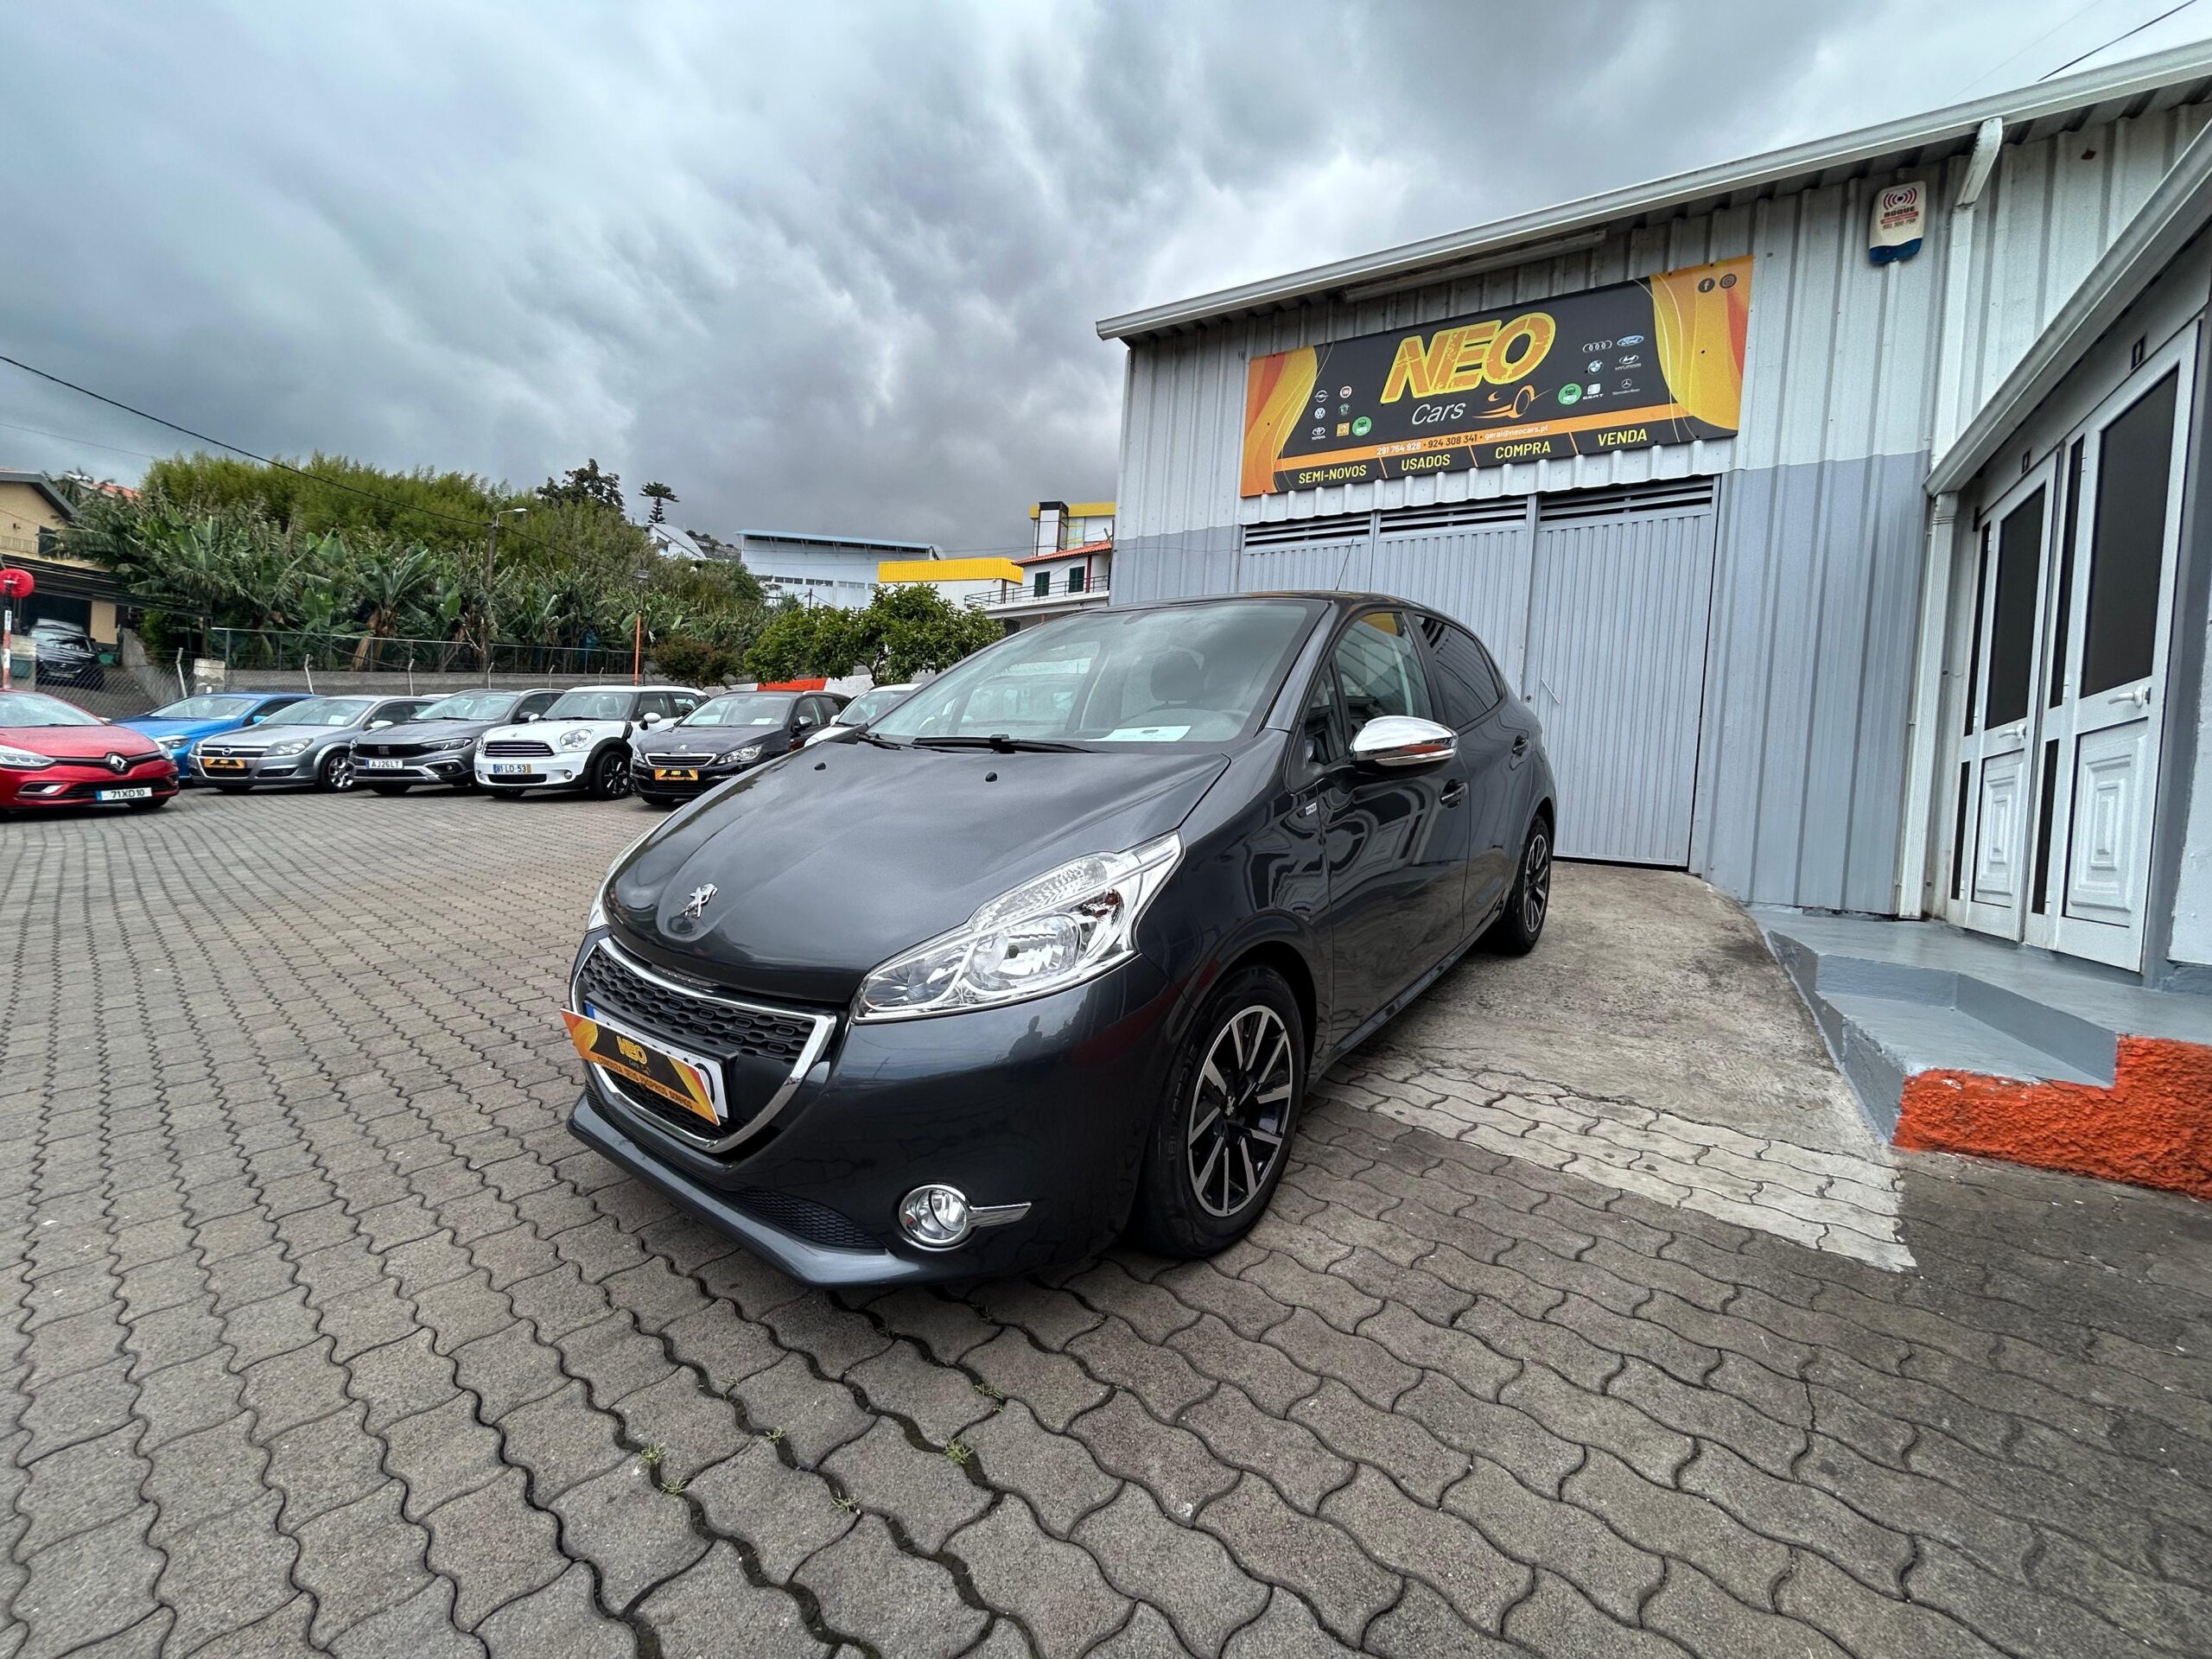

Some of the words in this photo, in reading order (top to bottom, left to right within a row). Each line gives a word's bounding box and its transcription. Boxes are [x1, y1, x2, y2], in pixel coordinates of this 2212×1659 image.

[1380, 312, 1556, 404] NEO
[1411, 402, 1467, 426] Cars
[1376, 447, 1389, 455] 291
[1391, 444, 1405, 454] 764
[1406, 442, 1421, 452] 928
[1427, 438, 1444, 448] 924
[1446, 436, 1462, 447] 308
[1463, 434, 1478, 444] 341
[1484, 424, 1548, 441] geral@neocars.pt
[1597, 428, 1648, 447] VENDA
[1495, 441, 1551, 459] COMPRA
[1401, 454, 1451, 471] USADOS
[1298, 464, 1367, 484] SEMI-NOVOS
[616, 1036, 647, 1065] NEO
